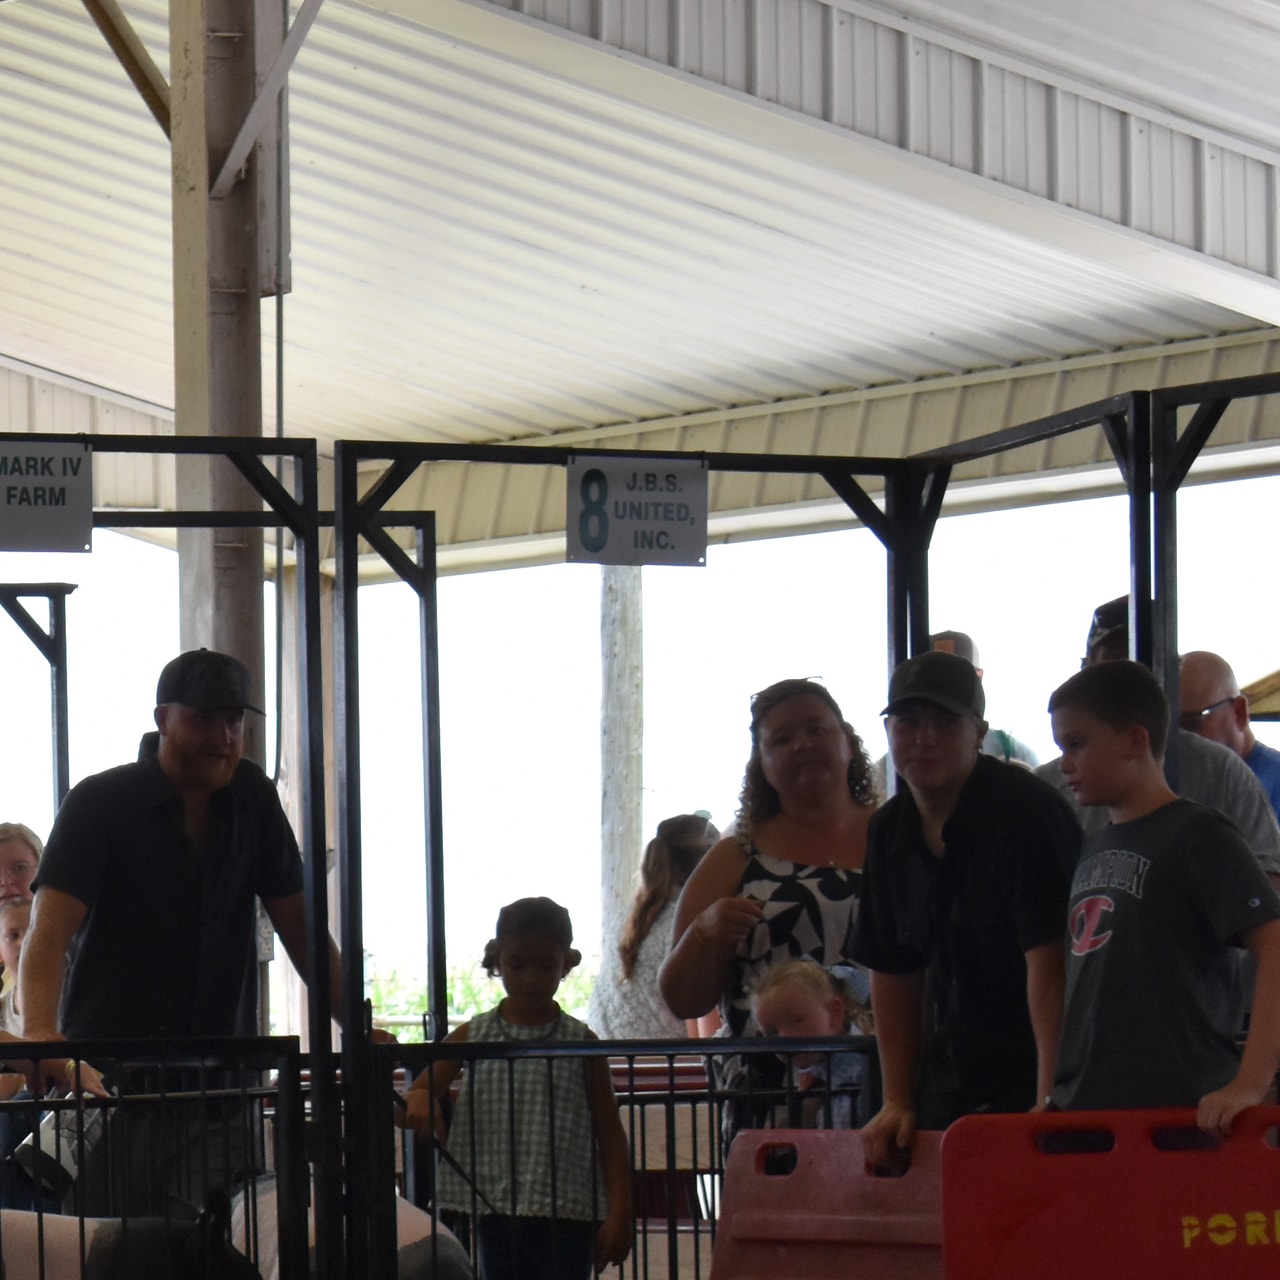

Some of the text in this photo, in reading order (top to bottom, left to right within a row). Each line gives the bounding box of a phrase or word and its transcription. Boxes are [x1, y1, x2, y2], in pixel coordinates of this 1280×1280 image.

[62, 457, 82, 476] IV
[626, 472, 683, 493] J.B.S.
[6, 486, 66, 506] FARM
[579, 468, 609, 553] 8
[614, 501, 695, 526] UNITED,
[633, 530, 675, 550] INC.
[1182, 1209, 1280, 1248] POR
